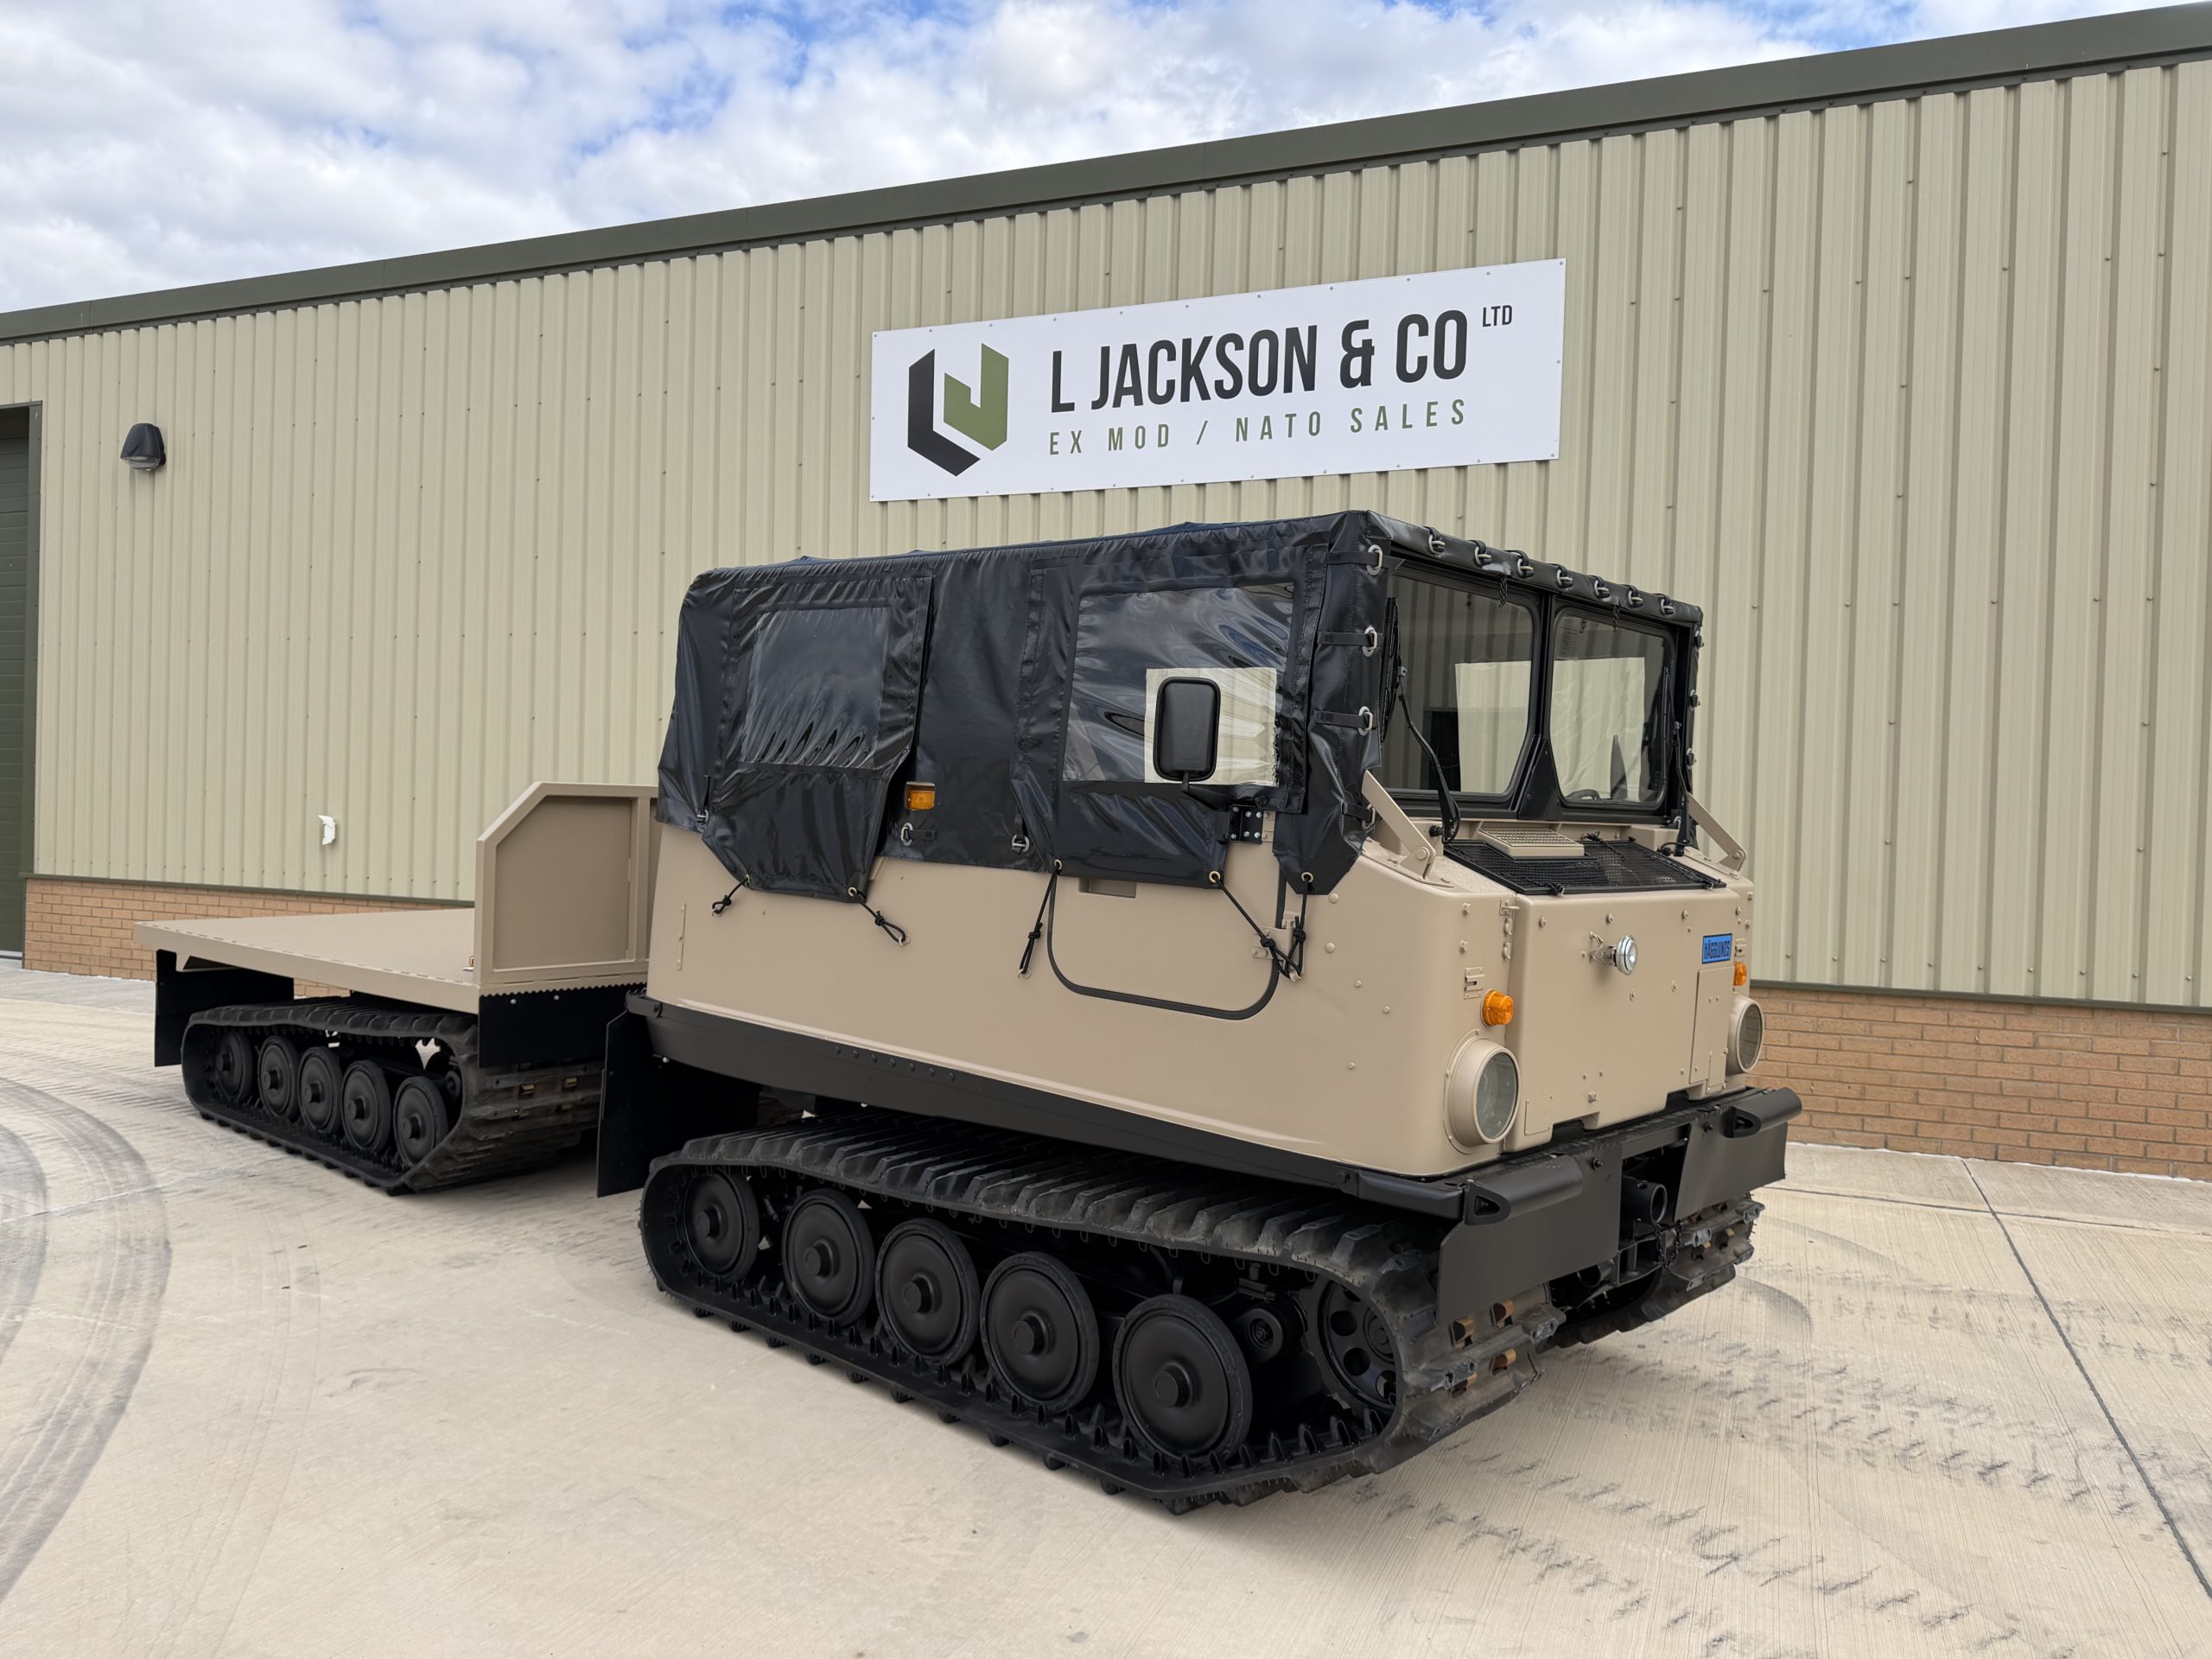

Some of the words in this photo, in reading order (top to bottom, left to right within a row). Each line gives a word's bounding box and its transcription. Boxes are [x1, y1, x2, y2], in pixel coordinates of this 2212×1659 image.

[1051, 350, 1076, 414] L
[1090, 324, 1318, 410] JACKSON
[1339, 319, 1376, 389] &
[1395, 309, 1468, 384] CO
[1482, 304, 1513, 327] LTD
[1049, 429, 1083, 455] EX
[1108, 423, 1169, 452] MOD
[1236, 410, 1321, 442] NATO
[1350, 398, 1465, 434] SALES
